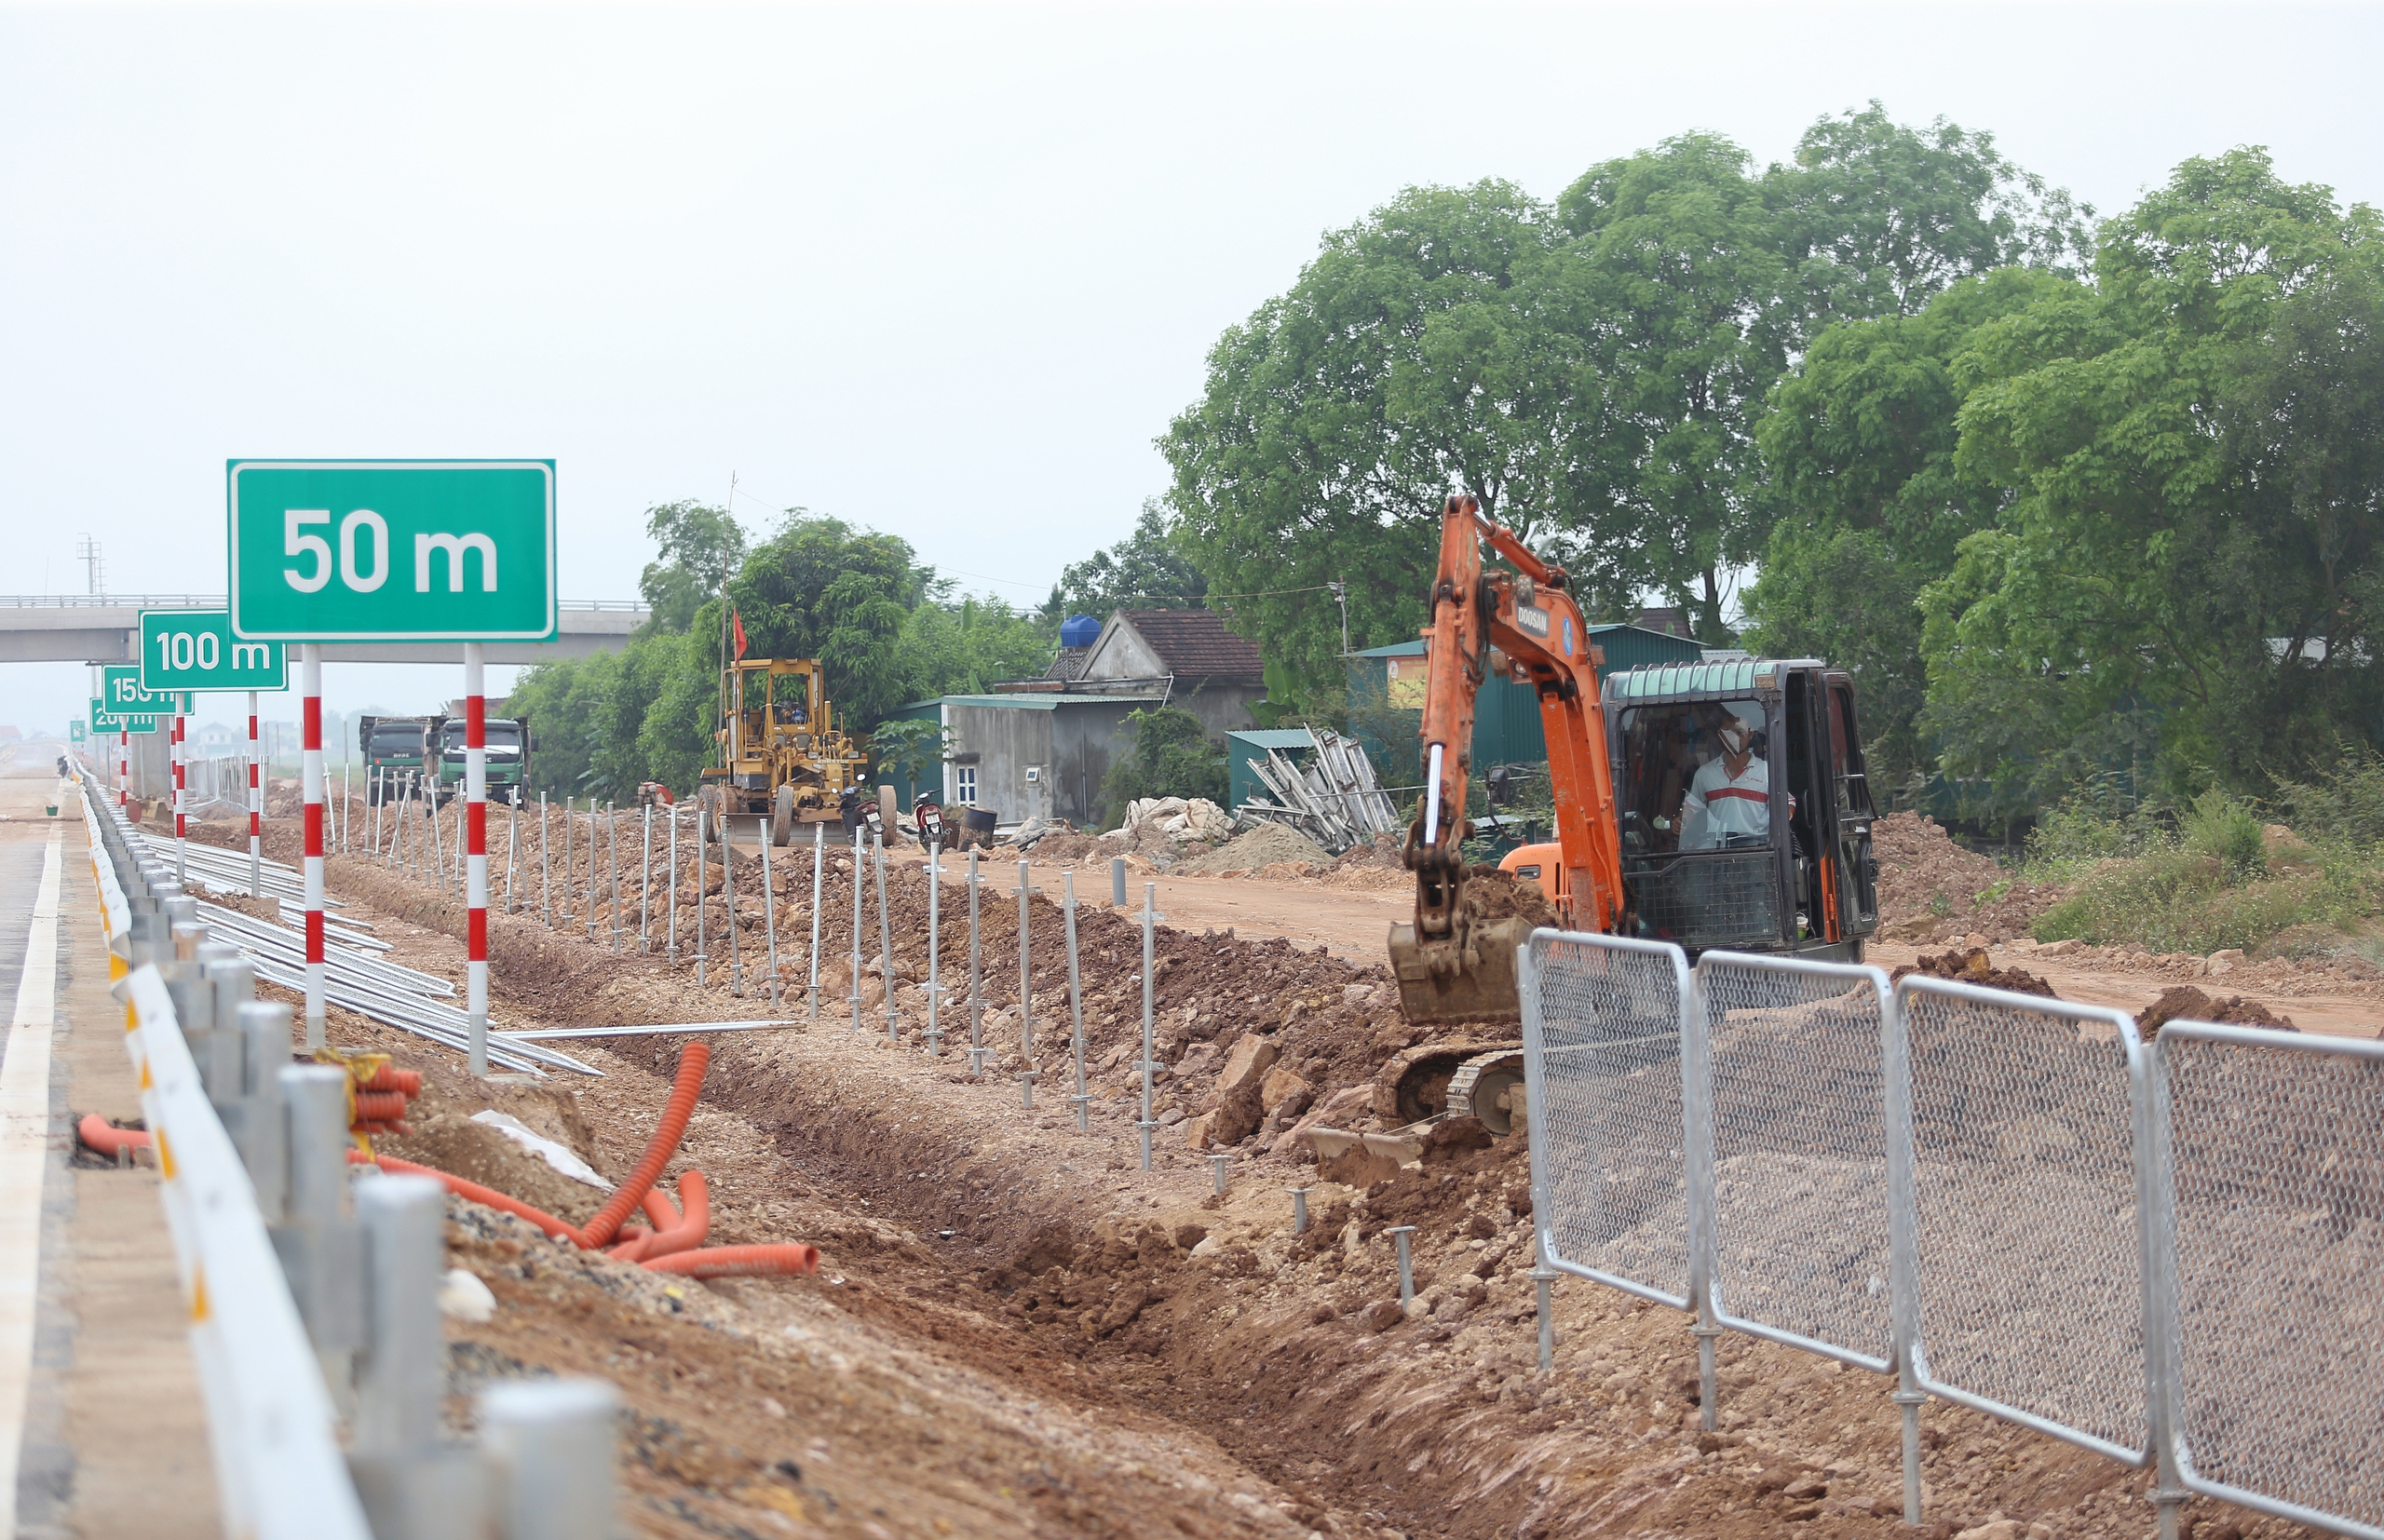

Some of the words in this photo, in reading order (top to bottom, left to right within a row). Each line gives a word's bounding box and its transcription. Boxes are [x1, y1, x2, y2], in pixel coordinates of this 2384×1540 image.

[284, 509, 389, 593] 50
[414, 533, 498, 593] m
[1518, 606, 1547, 632] DOOSAN
[156, 631, 220, 670] 100
[232, 643, 270, 669] m
[95, 708, 129, 725] 20
